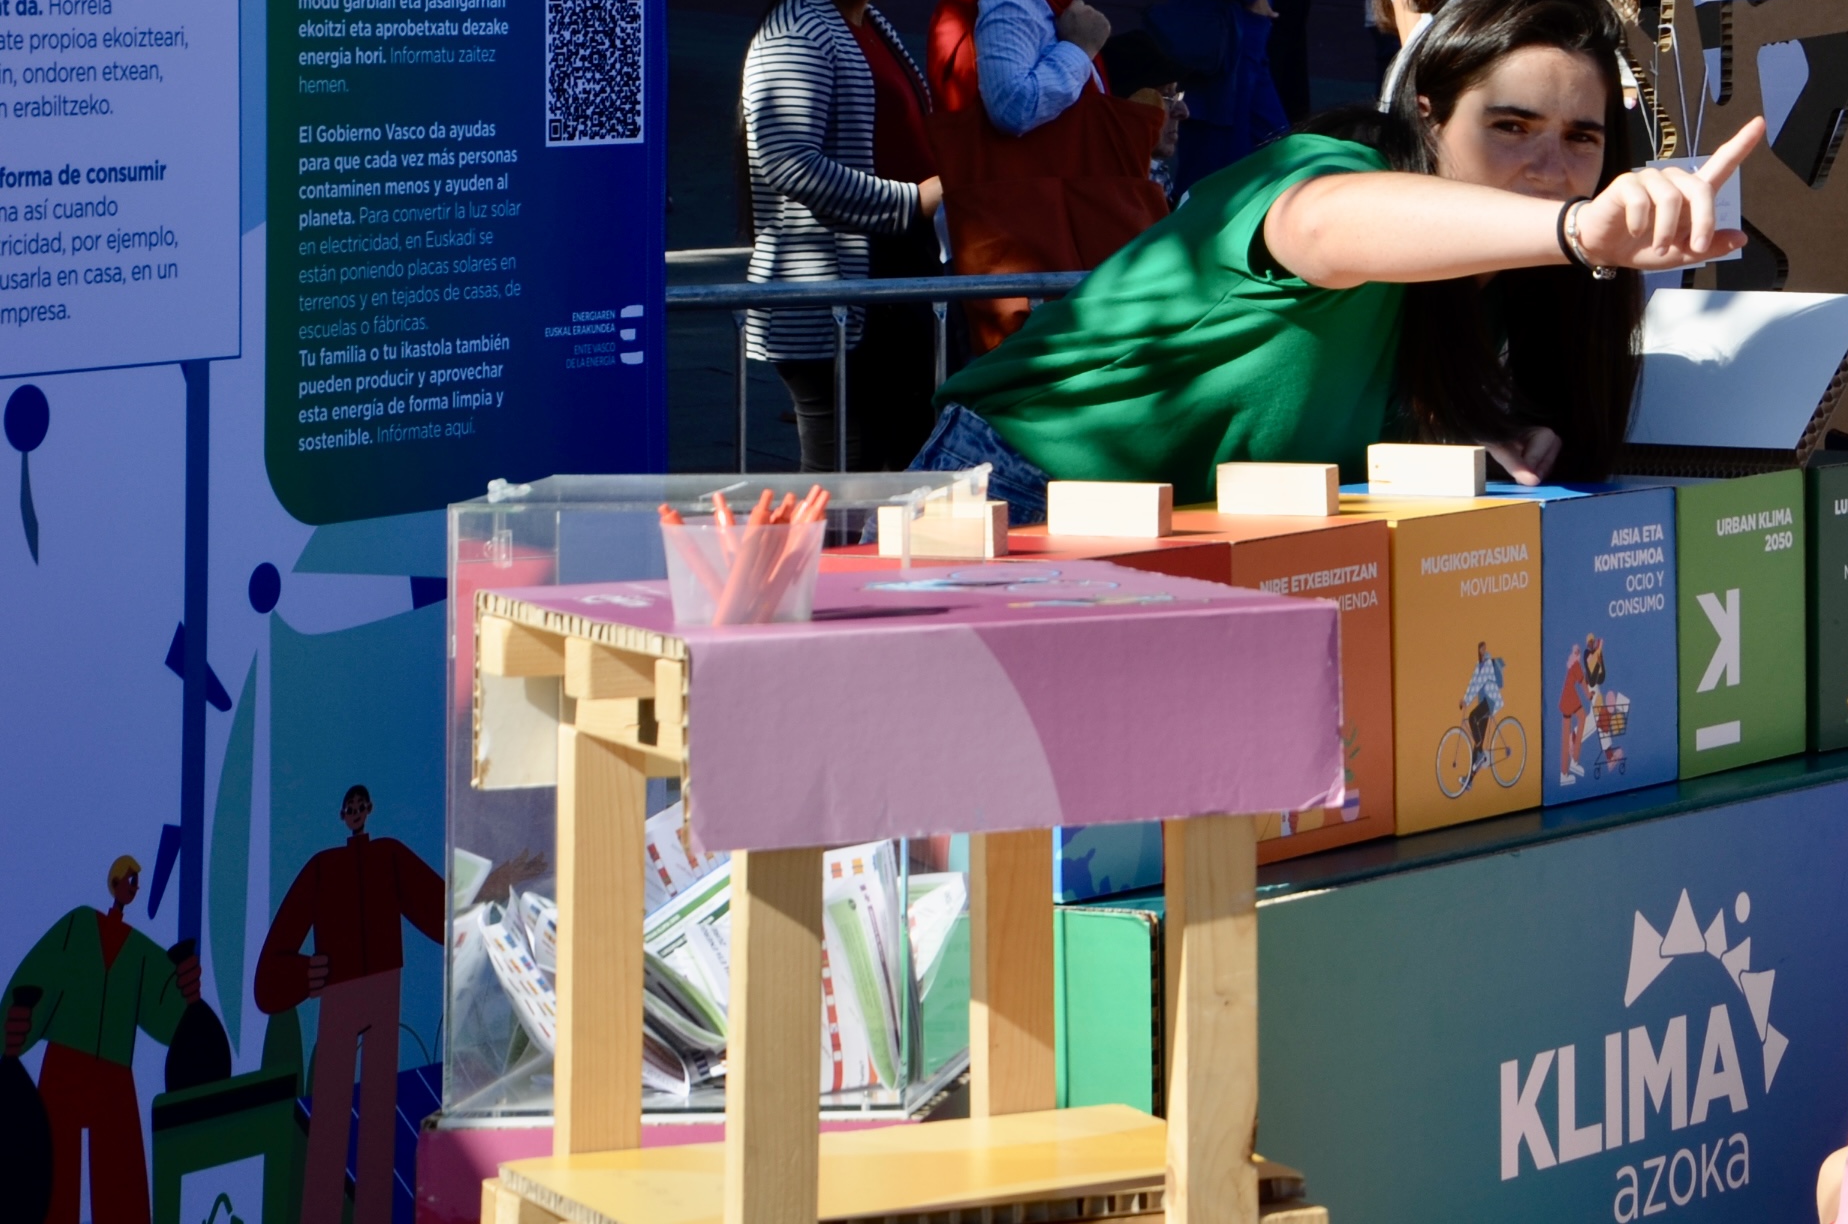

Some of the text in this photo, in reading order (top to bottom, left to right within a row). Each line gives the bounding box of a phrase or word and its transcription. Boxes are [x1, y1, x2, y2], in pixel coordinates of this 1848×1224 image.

[299, 19, 508, 39] ekoitzi eta aprobetxatu dezake
[299, 47, 386, 68] energia hori.
[13, 95, 114, 119] erabiltzeko.
[299, 120, 496, 143] El Gobierno Vasco da ayudas
[58, 164, 81, 186] de
[86, 160, 167, 185] consumir
[299, 148, 517, 174] para que cada vez más personas
[299, 173, 508, 199] contaminen menos y ayuden al
[24, 195, 118, 221] así cuando
[299, 209, 355, 231] planeta.
[0, 259, 178, 290] usarla en casa, en un
[300, 335, 510, 367] Tu familia o tu ikastola también
[299, 363, 503, 398] pueden producir y aprovechar
[299, 388, 503, 423] esta energía de forma limpia y
[299, 427, 373, 451] sostenible.
[1716, 507, 1793, 537] URBAN KLIMA
[1611, 524, 1664, 548] AISIA ETA
[1764, 531, 1793, 553] 2050
[1421, 544, 1529, 576] MUGIKORTASUNA
[1594, 547, 1664, 573] KONTSUMOA
[1291, 562, 1377, 593] ETXEBIZITZAN
[1460, 571, 1529, 598] MOVILIDAD
[1626, 571, 1664, 592] OCIO Y
[1609, 593, 1665, 618] CONSUMO
[1500, 1003, 1749, 1182] KLIMA
[1613, 1132, 1750, 1224] azoka
